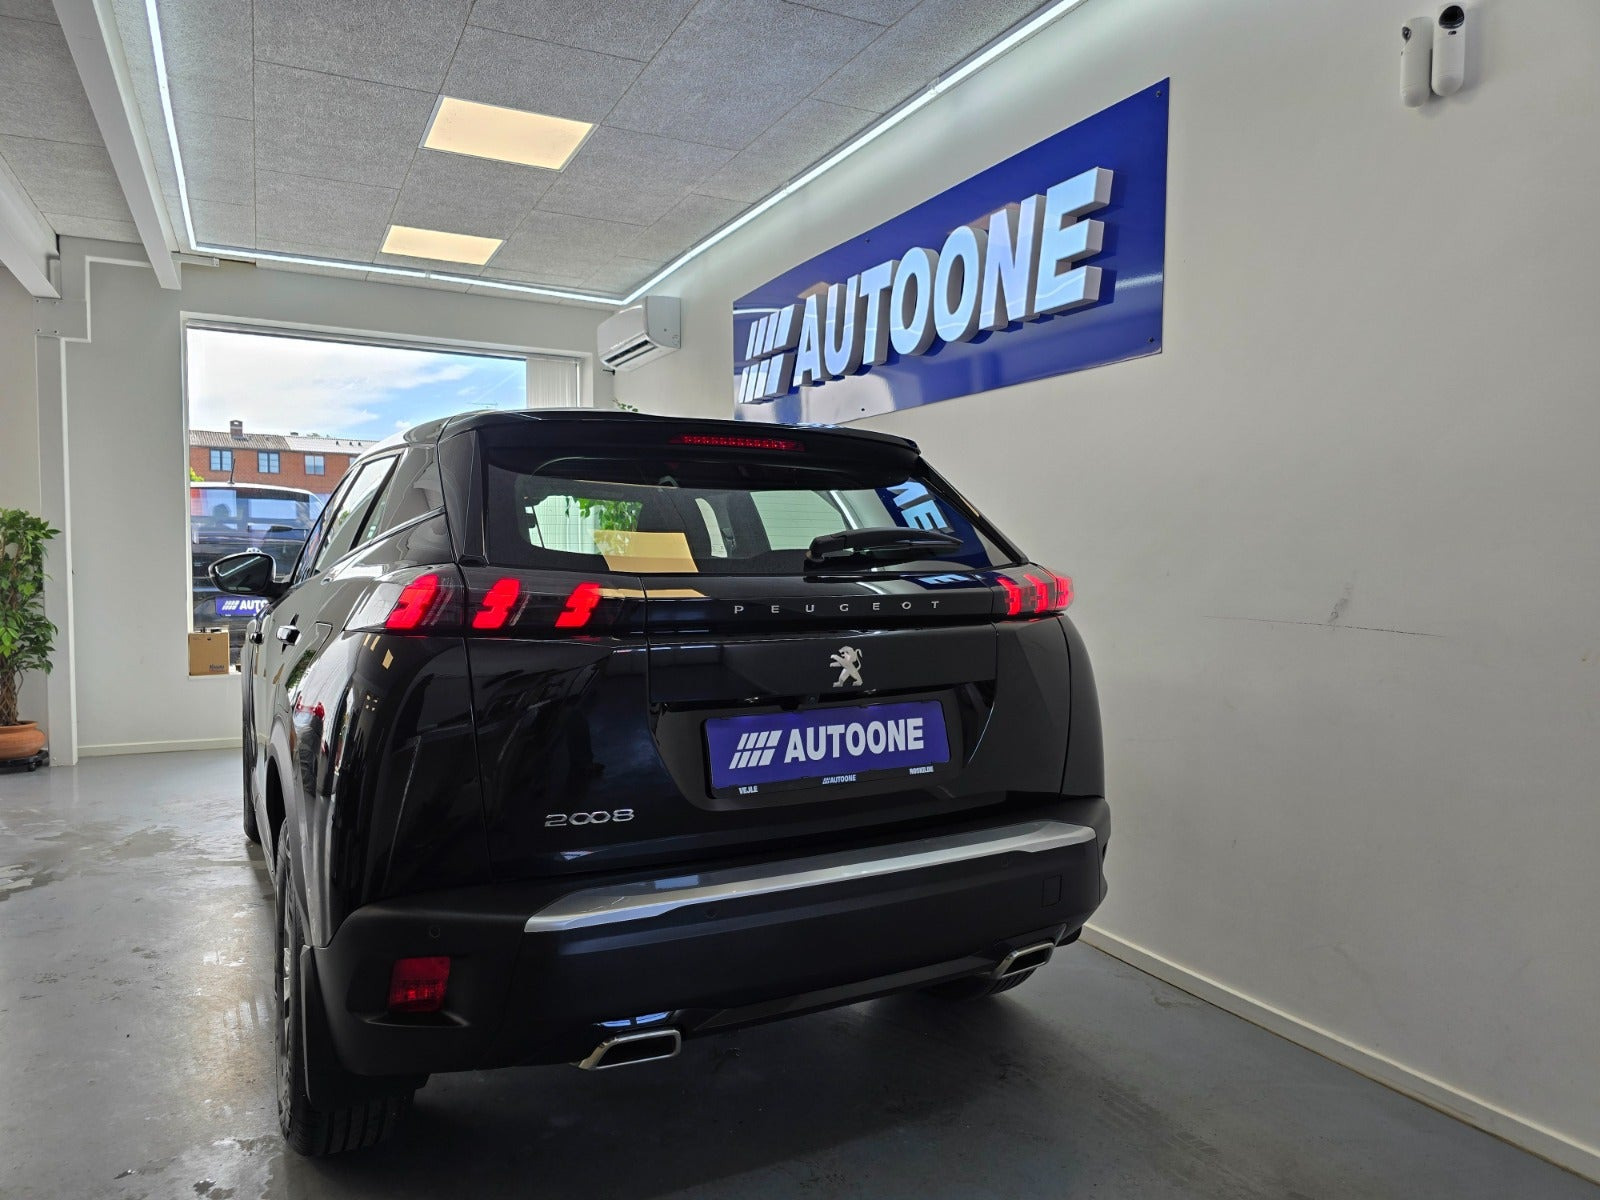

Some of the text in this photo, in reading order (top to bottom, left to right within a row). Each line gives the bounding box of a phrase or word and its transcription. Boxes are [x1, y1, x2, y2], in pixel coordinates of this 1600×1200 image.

[792, 167, 1113, 387] AUTOONE
[734, 600, 939, 614] PEUGEOT
[784, 717, 924, 763] AUTOONE
[829, 774, 857, 784] AUTOONE
[738, 785, 758, 795] VEJLE
[544, 808, 635, 828] 2008
